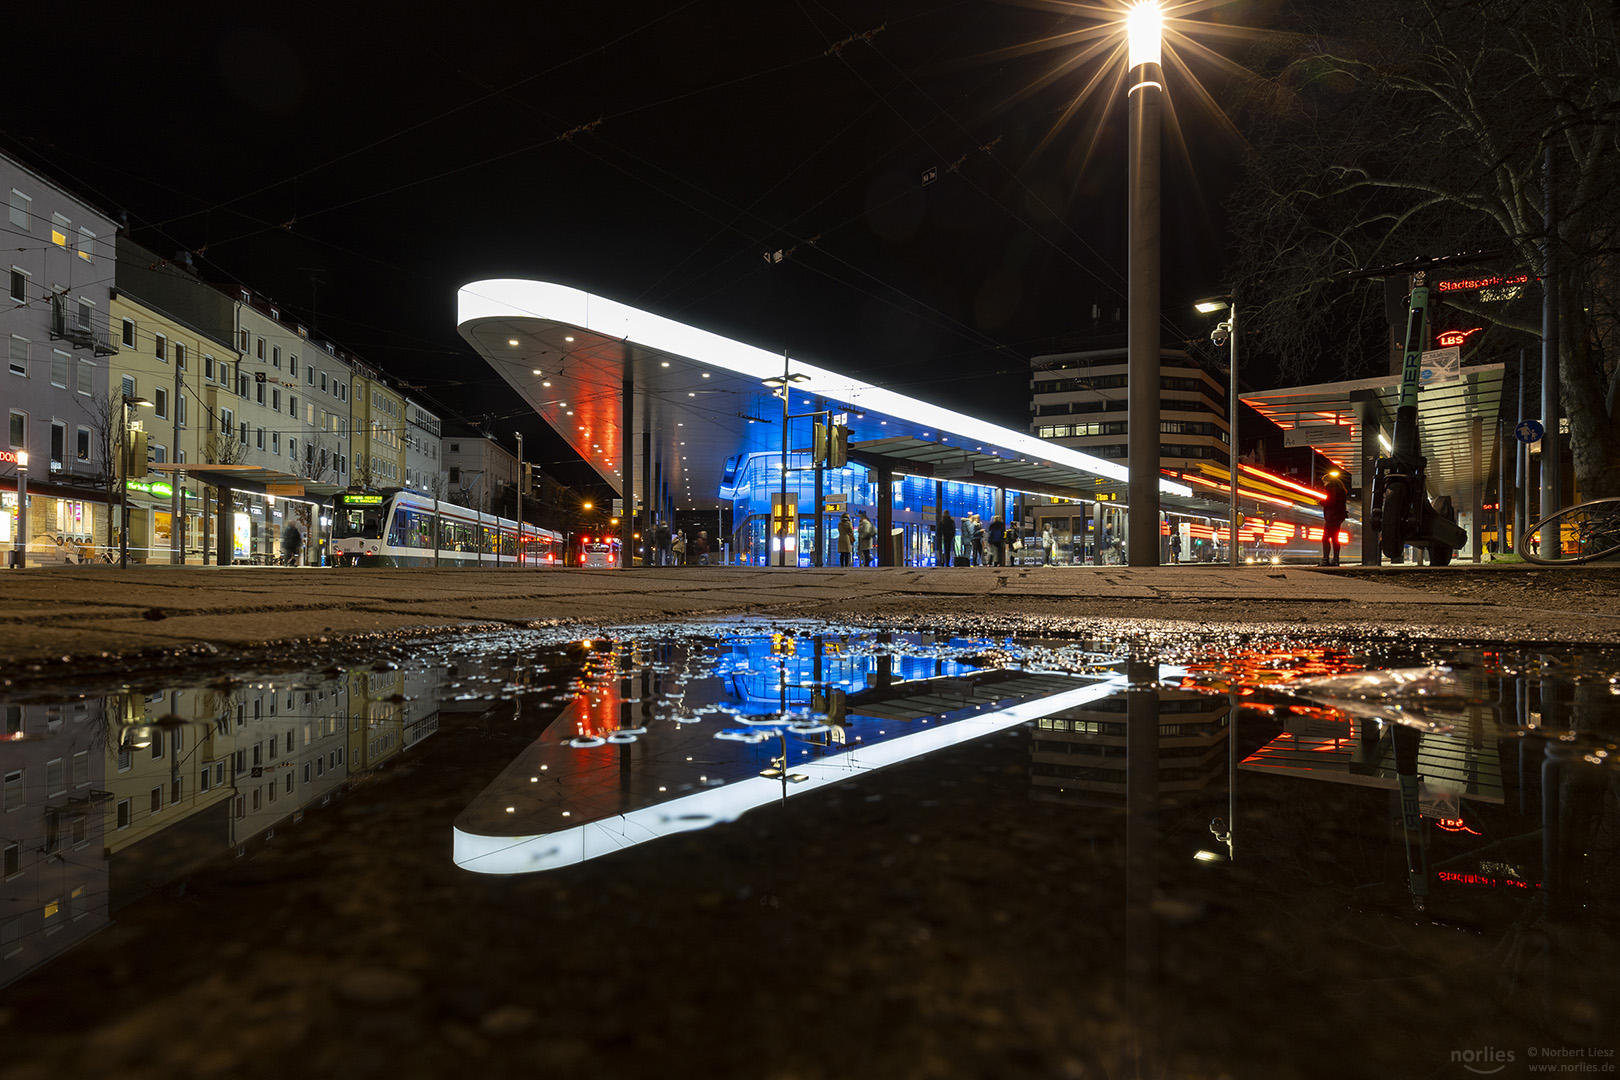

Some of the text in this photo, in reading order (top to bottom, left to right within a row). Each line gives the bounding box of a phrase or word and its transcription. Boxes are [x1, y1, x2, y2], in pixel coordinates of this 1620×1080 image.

[1439, 274, 1529, 292] Stadtsparksse
[1441, 335, 1464, 346] LBS
[1401, 353, 1419, 403] TIER
[344, 495, 350, 503] 2
